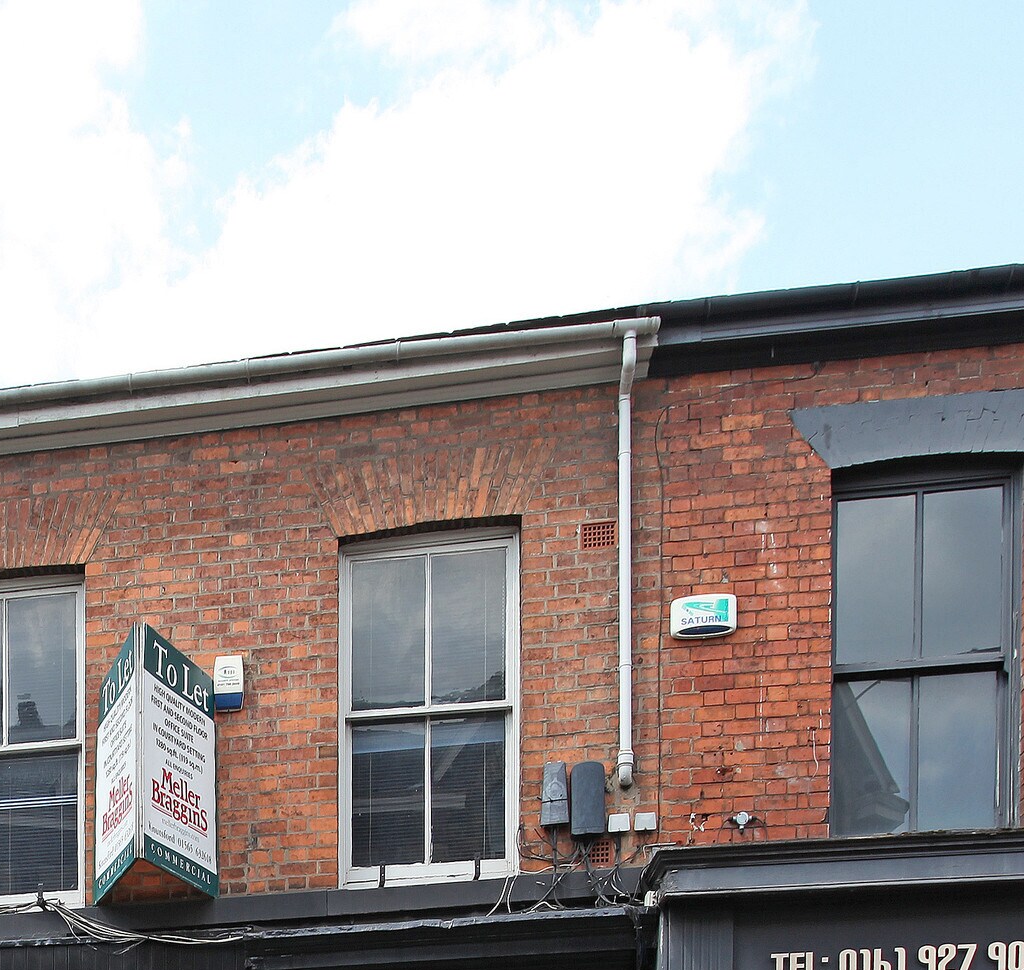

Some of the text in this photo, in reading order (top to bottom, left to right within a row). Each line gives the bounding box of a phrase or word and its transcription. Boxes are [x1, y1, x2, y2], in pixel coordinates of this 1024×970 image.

[681, 616, 722, 626] SATURN
[102, 677, 116, 715] To
[118, 650, 133, 693] Let
[153, 639, 178, 687] To
[182, 663, 209, 712] Let
[164, 718, 180, 734] OFFICE
[161, 767, 201, 810] Meller
[150, 843, 212, 885] COMMERCIAL
